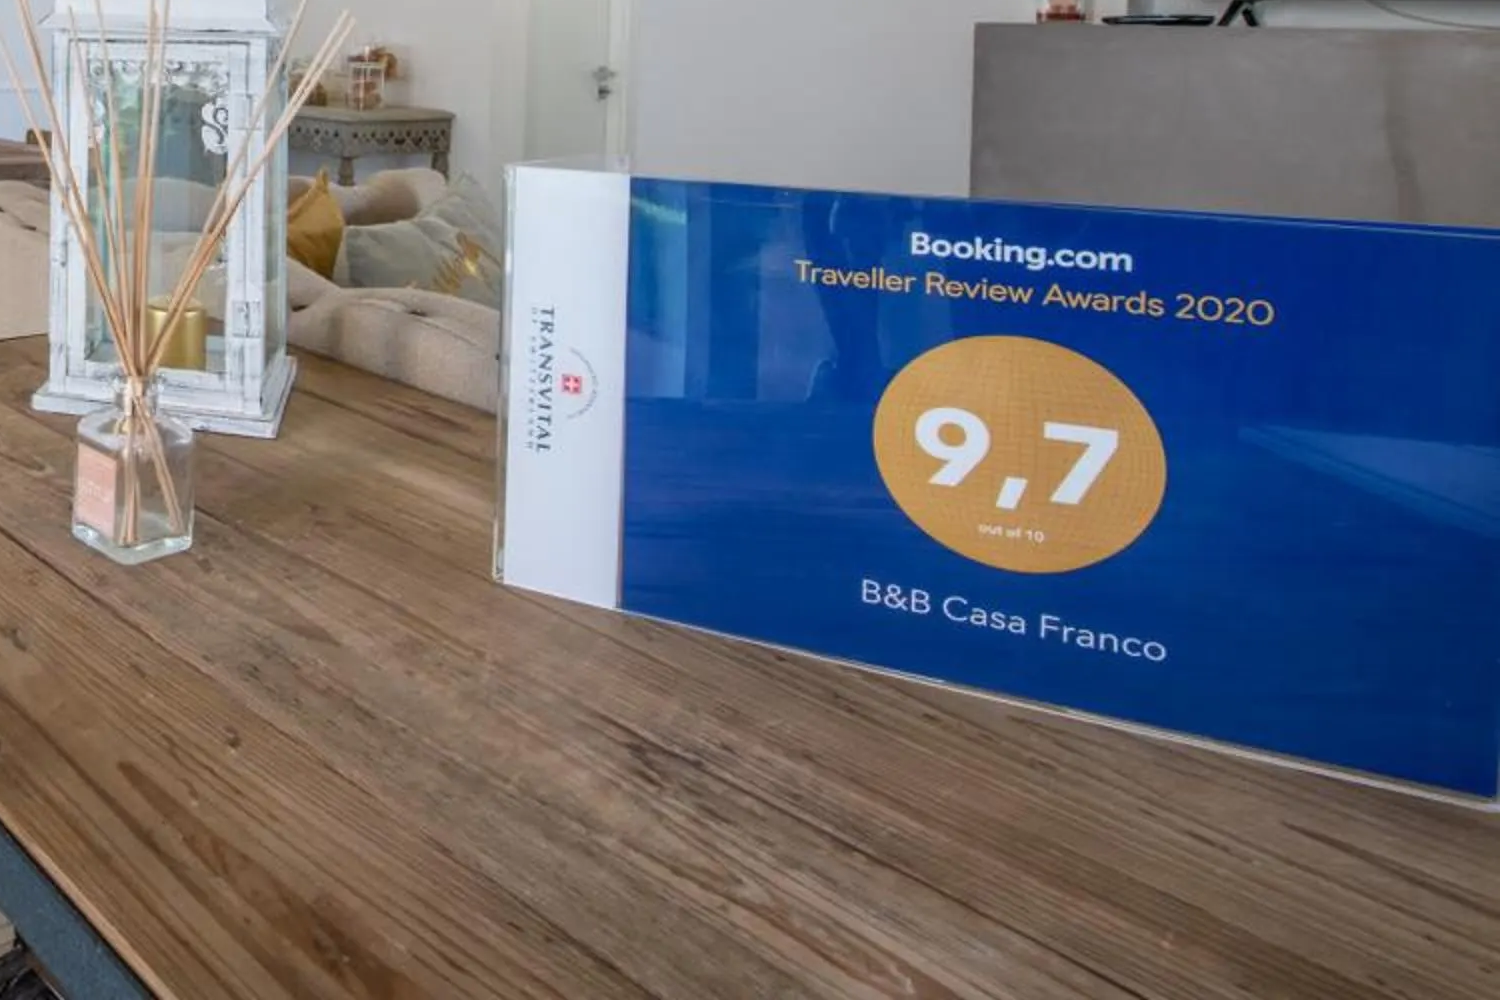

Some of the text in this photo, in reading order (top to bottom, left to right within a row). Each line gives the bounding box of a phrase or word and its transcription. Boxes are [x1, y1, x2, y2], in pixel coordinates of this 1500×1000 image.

[910, 231, 1134, 273] Booking.com
[793, 258, 1275, 326] Traveller Review Awards 2020
[536, 304, 556, 454] TRANSVITAL
[913, 406, 1120, 511] 9,7
[978, 523, 1045, 544] out of 10
[860, 579, 1168, 662] B&B Casa Franco
